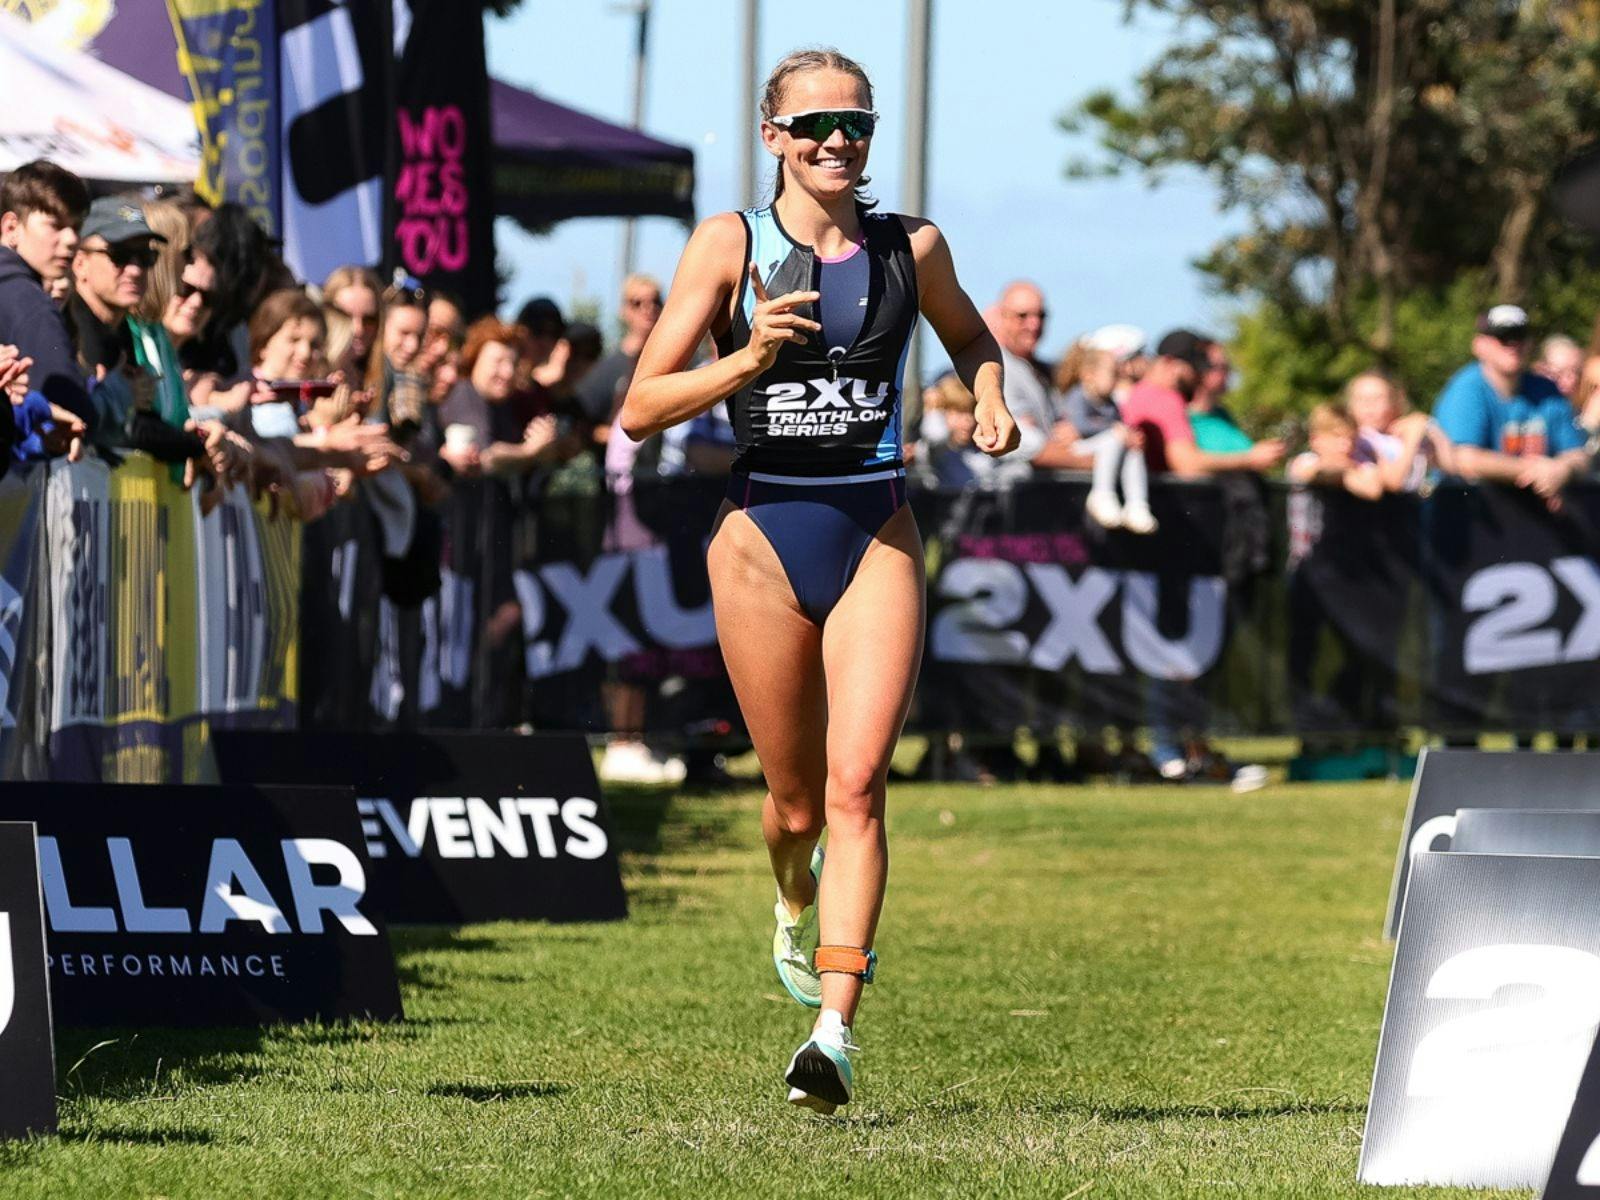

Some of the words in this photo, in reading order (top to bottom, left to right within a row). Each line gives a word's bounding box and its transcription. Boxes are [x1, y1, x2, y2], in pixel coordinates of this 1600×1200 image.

[766, 377, 889, 411] 2XU
[767, 409, 887, 425] TRIATHLON
[767, 423, 848, 437] SERIES
[932, 556, 1228, 680] 2XU
[356, 797, 608, 860] EVENTS
[37, 836, 378, 935] LLAR
